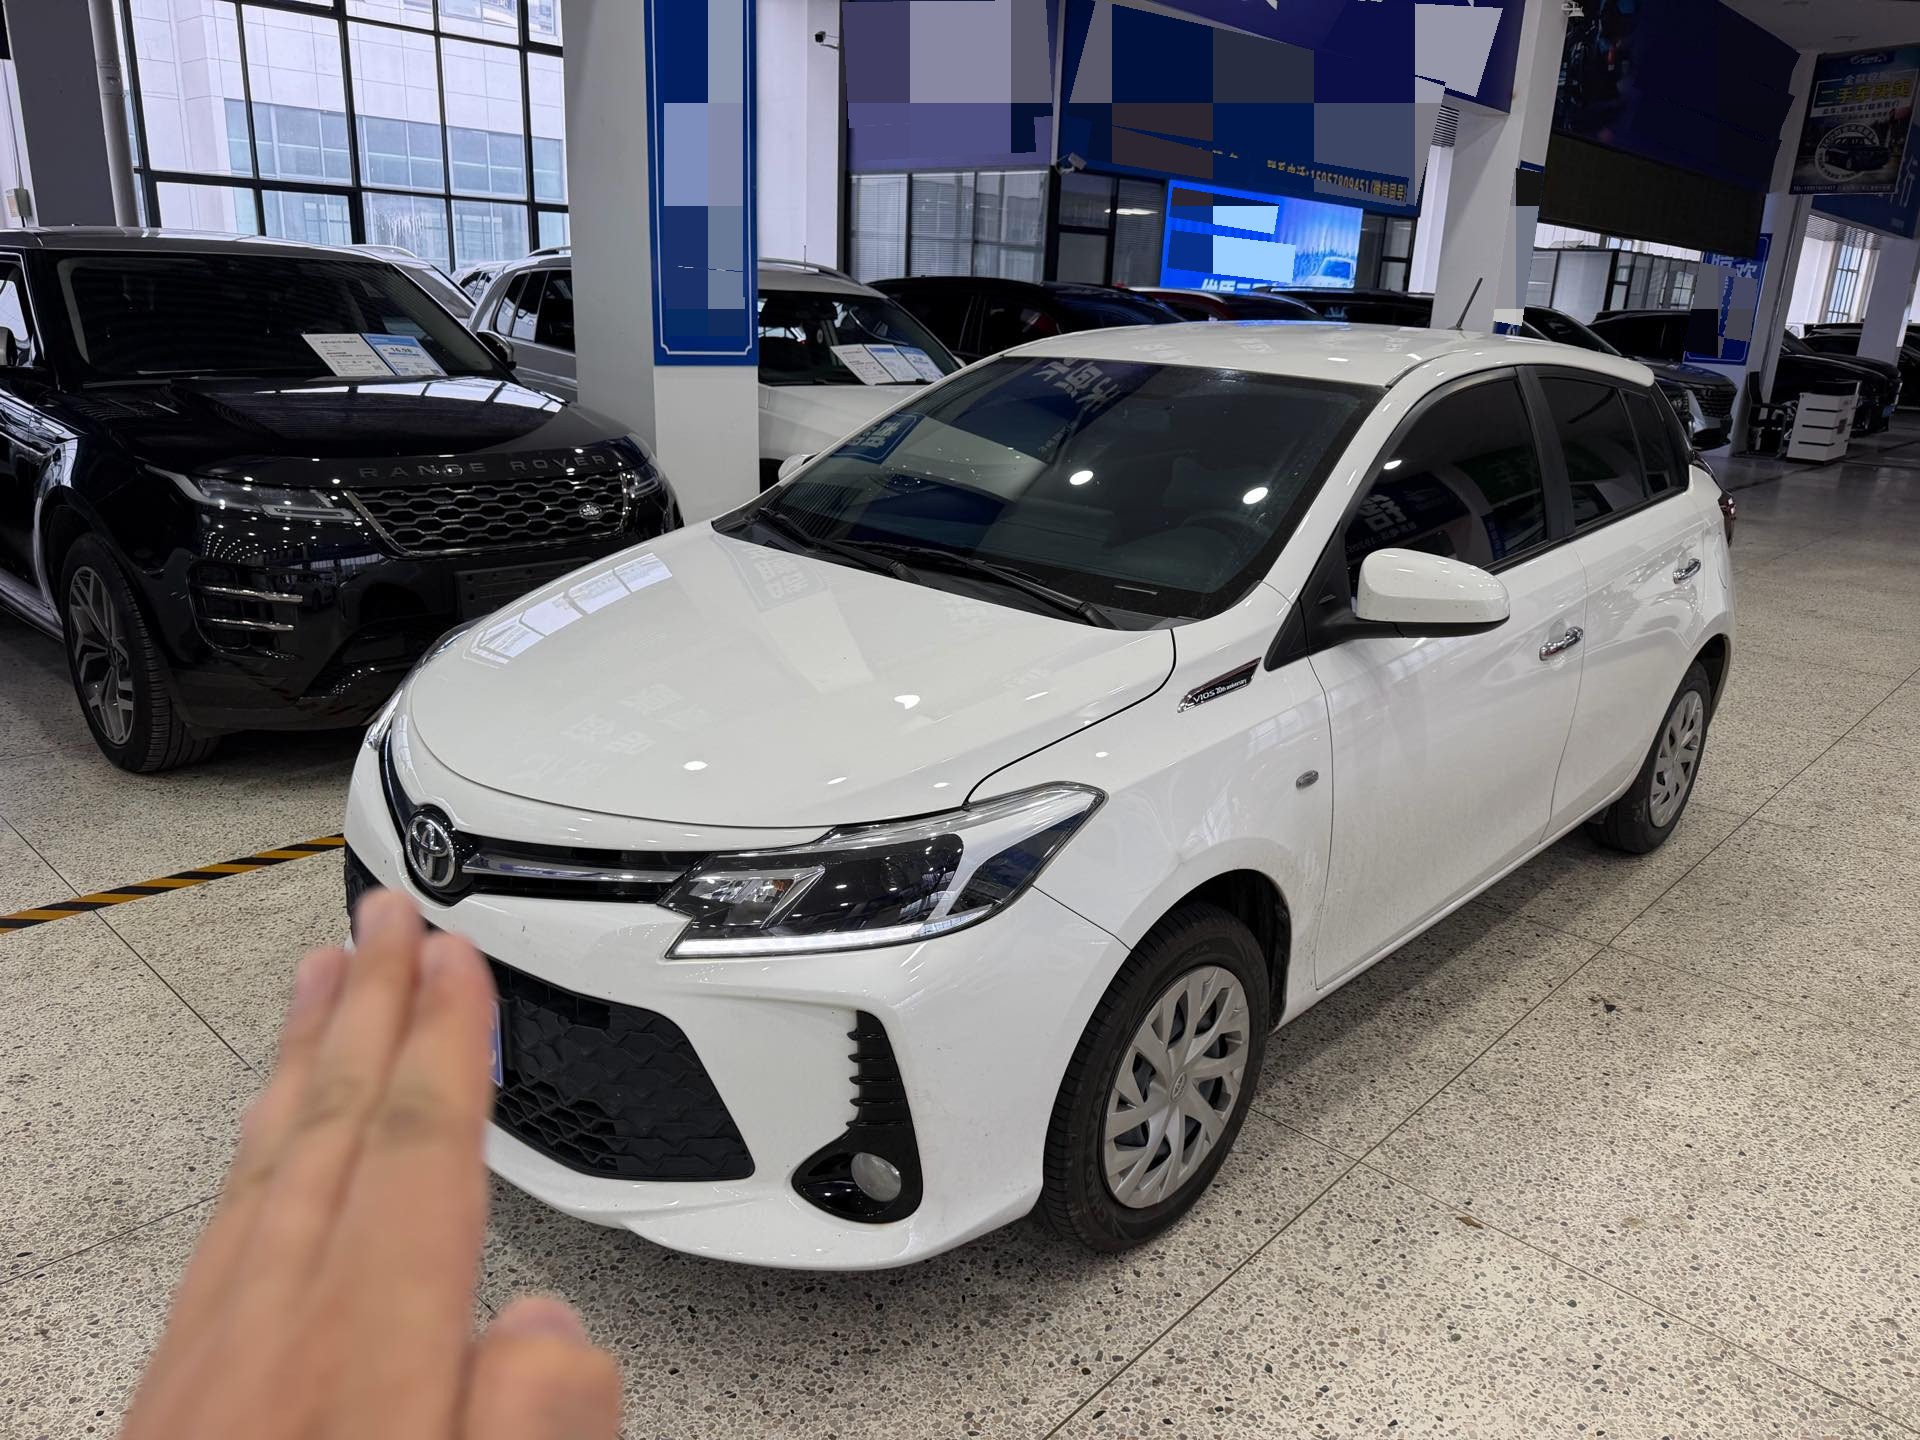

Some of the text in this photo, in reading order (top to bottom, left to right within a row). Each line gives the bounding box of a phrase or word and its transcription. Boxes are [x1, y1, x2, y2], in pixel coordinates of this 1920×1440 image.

[360, 454, 608, 479] RANGE ROVER
[1193, 690, 1216, 702] VIOS
